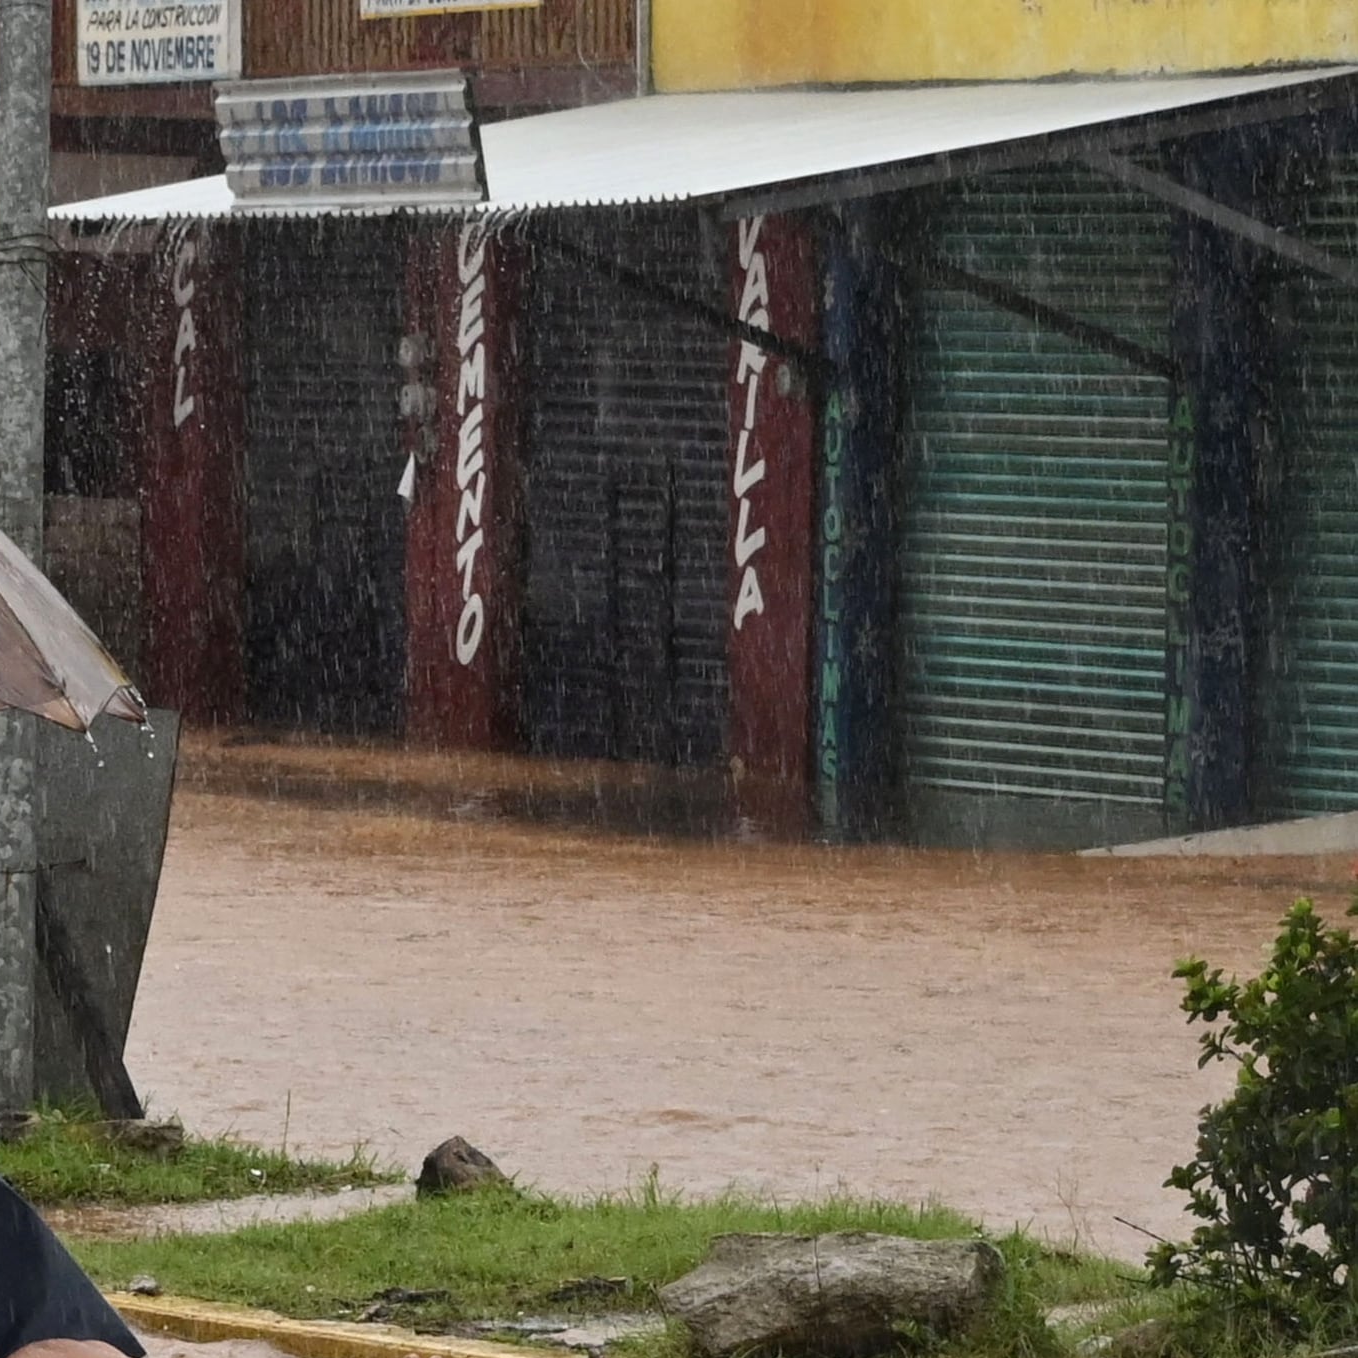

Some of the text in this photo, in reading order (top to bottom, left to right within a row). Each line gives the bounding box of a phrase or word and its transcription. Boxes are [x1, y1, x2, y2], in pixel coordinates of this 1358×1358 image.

[87, 10, 121, 32] PARA
[125, 8, 139, 30] LA
[106, 40, 126, 73] DE
[173, 241, 196, 431] CAL
[456, 217, 486, 665] CEMENTO
[734, 215, 769, 630] VARILLA
[823, 391, 842, 781] AUTOCLIMAS
